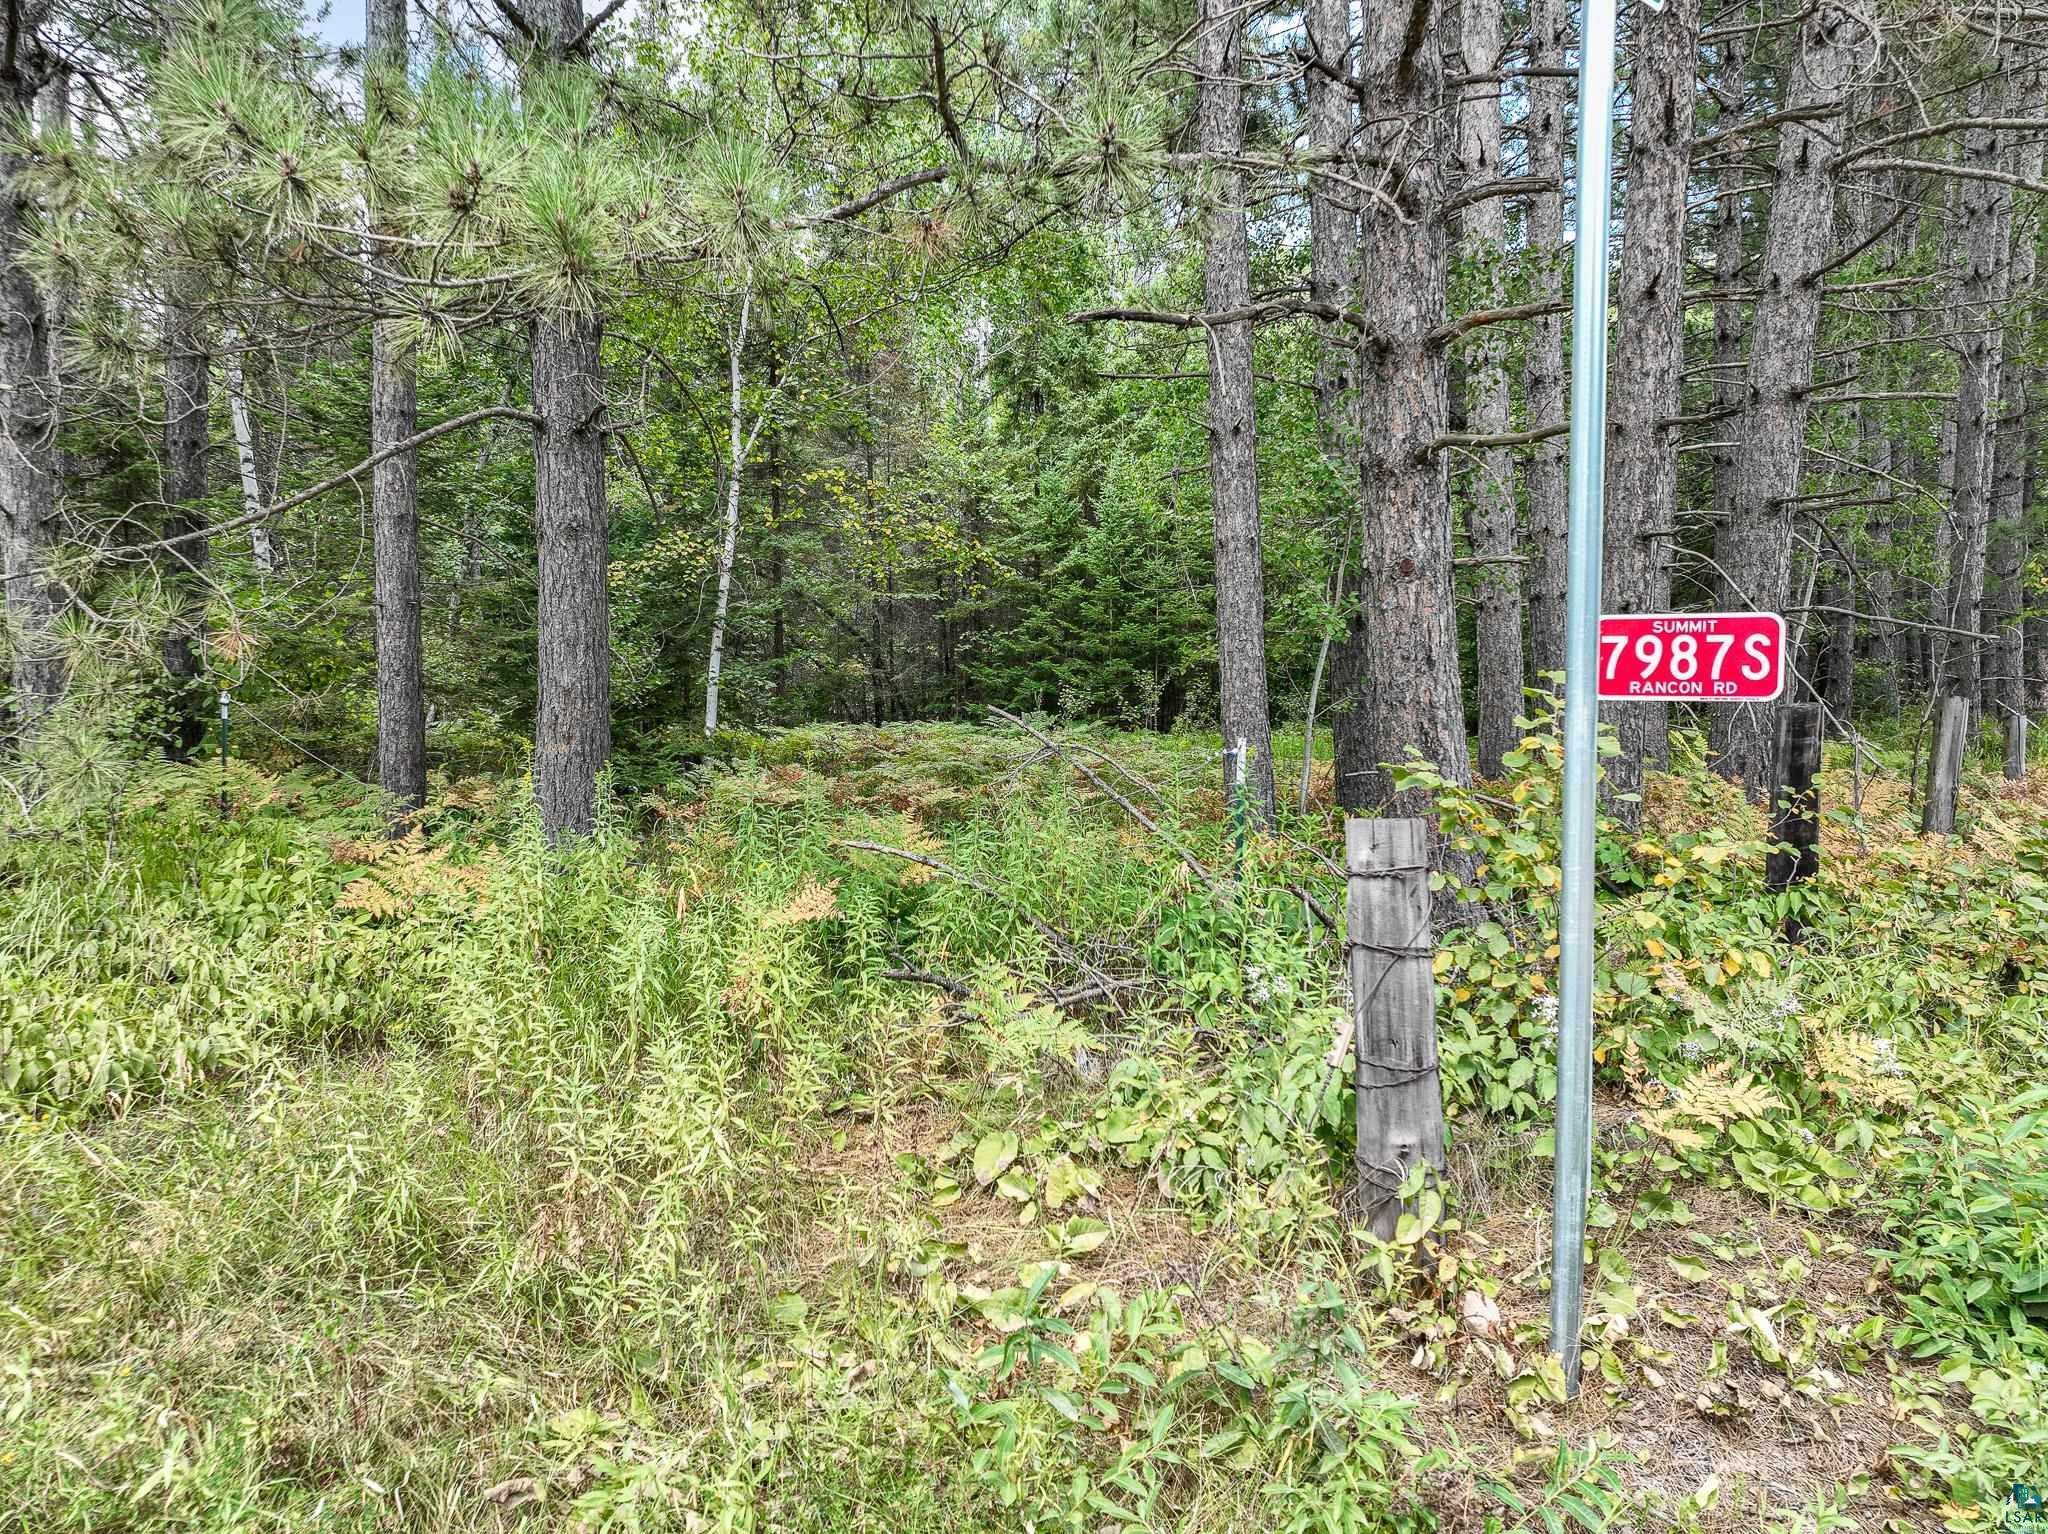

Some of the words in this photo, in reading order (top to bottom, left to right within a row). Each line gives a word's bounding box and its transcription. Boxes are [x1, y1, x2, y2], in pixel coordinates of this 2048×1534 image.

[1652, 620, 1718, 633] SUMMIT
[1600, 633, 1772, 681] 7987S
[1629, 681, 1703, 694] RANCON
[1713, 682, 1738, 694] RD
